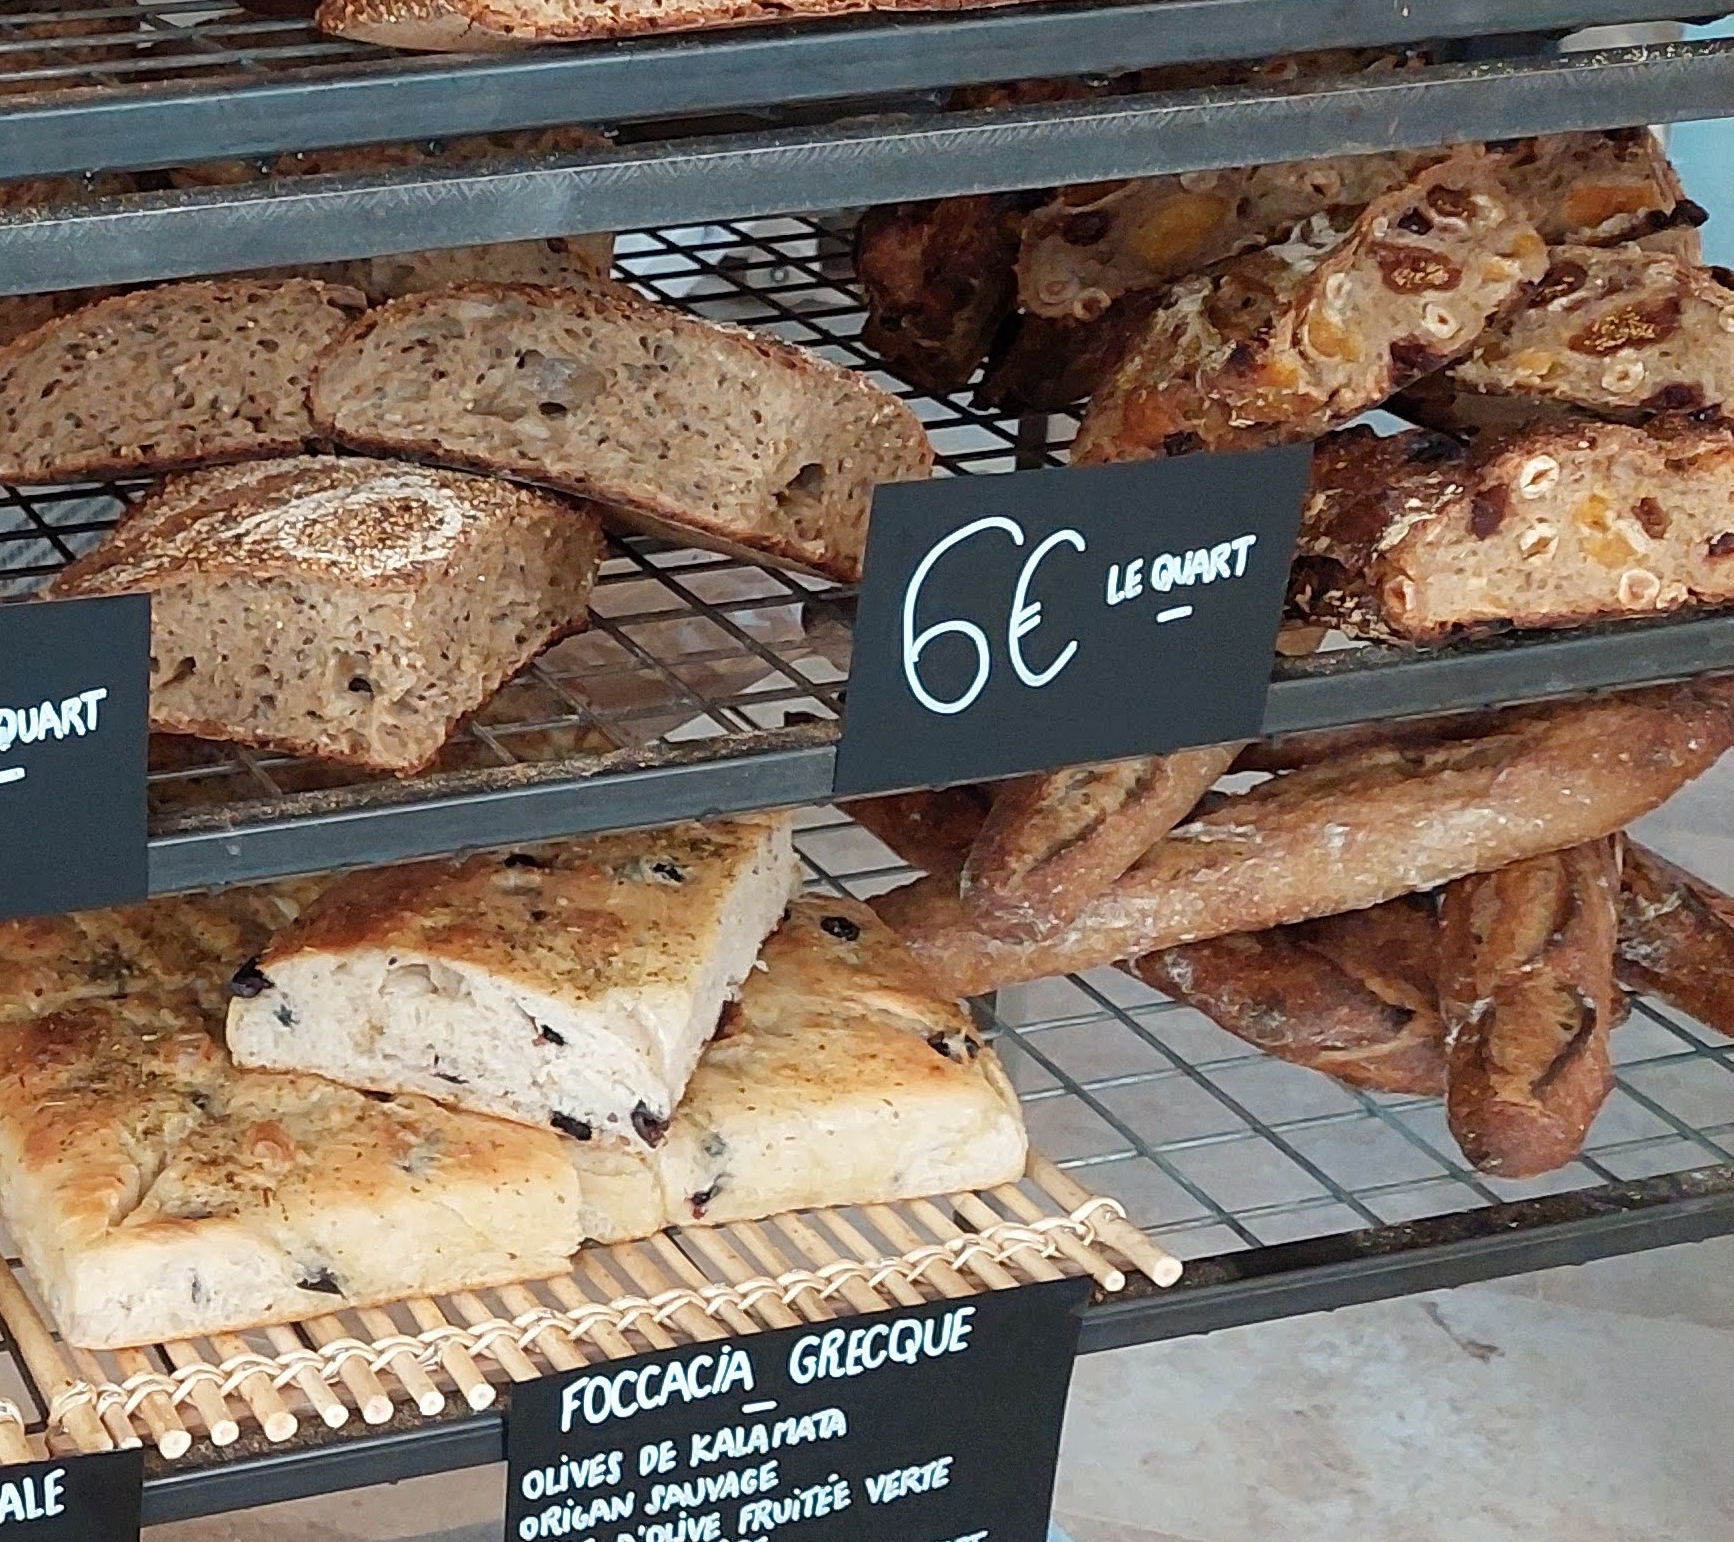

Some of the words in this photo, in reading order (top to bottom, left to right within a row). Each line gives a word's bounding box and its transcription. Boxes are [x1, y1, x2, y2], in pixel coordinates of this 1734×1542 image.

[904, 516, 1085, 714] 6€
[1106, 559, 1144, 606] LE
[1150, 535, 1256, 592] QUART
[789, 1307, 976, 1384] GRECQUE
[639, 1440, 677, 1475] DE
[690, 1408, 848, 1467] KALAMATA
[644, 1461, 780, 1515] SAUVAGE
[866, 1456, 953, 1505] VERTE
